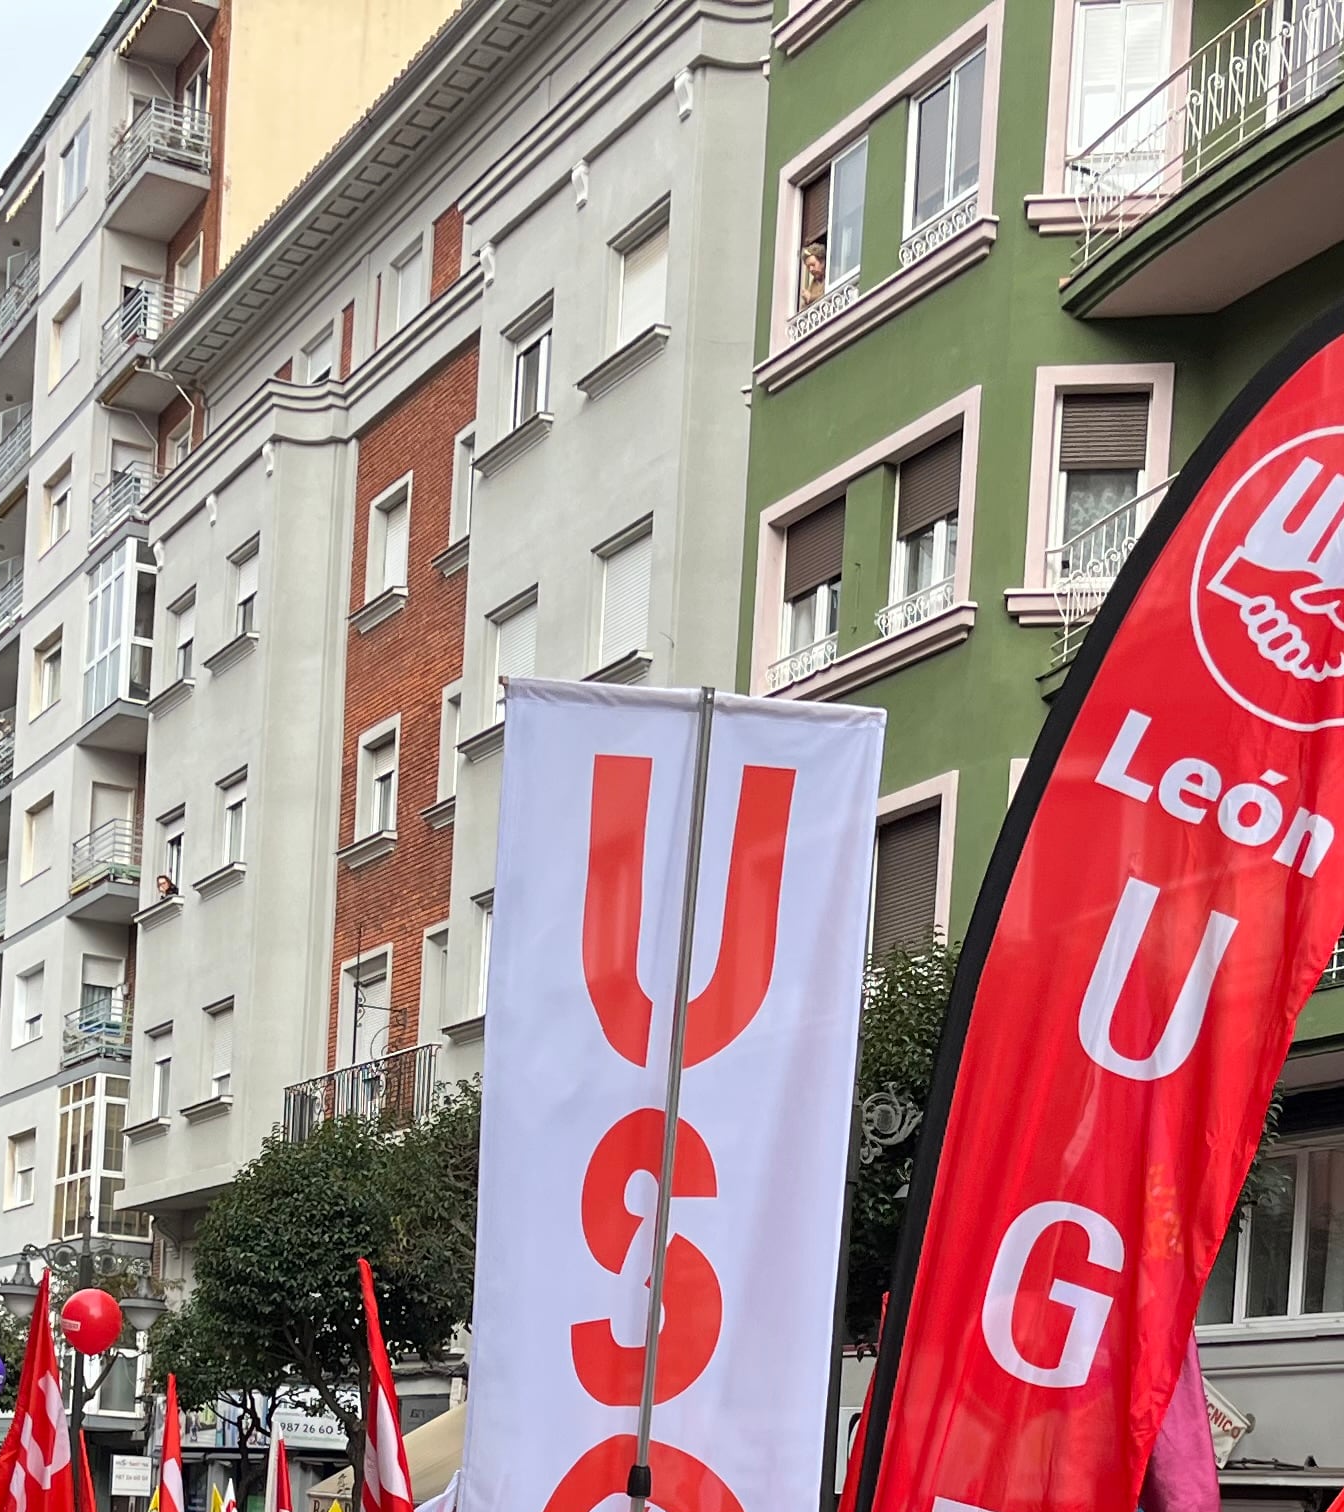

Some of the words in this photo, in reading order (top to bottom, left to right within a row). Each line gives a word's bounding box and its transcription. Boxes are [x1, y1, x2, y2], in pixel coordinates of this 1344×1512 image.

[1094, 709, 1335, 878] León
[303, 1424, 316, 1433] 26
[319, 1425, 334, 1434] 60
